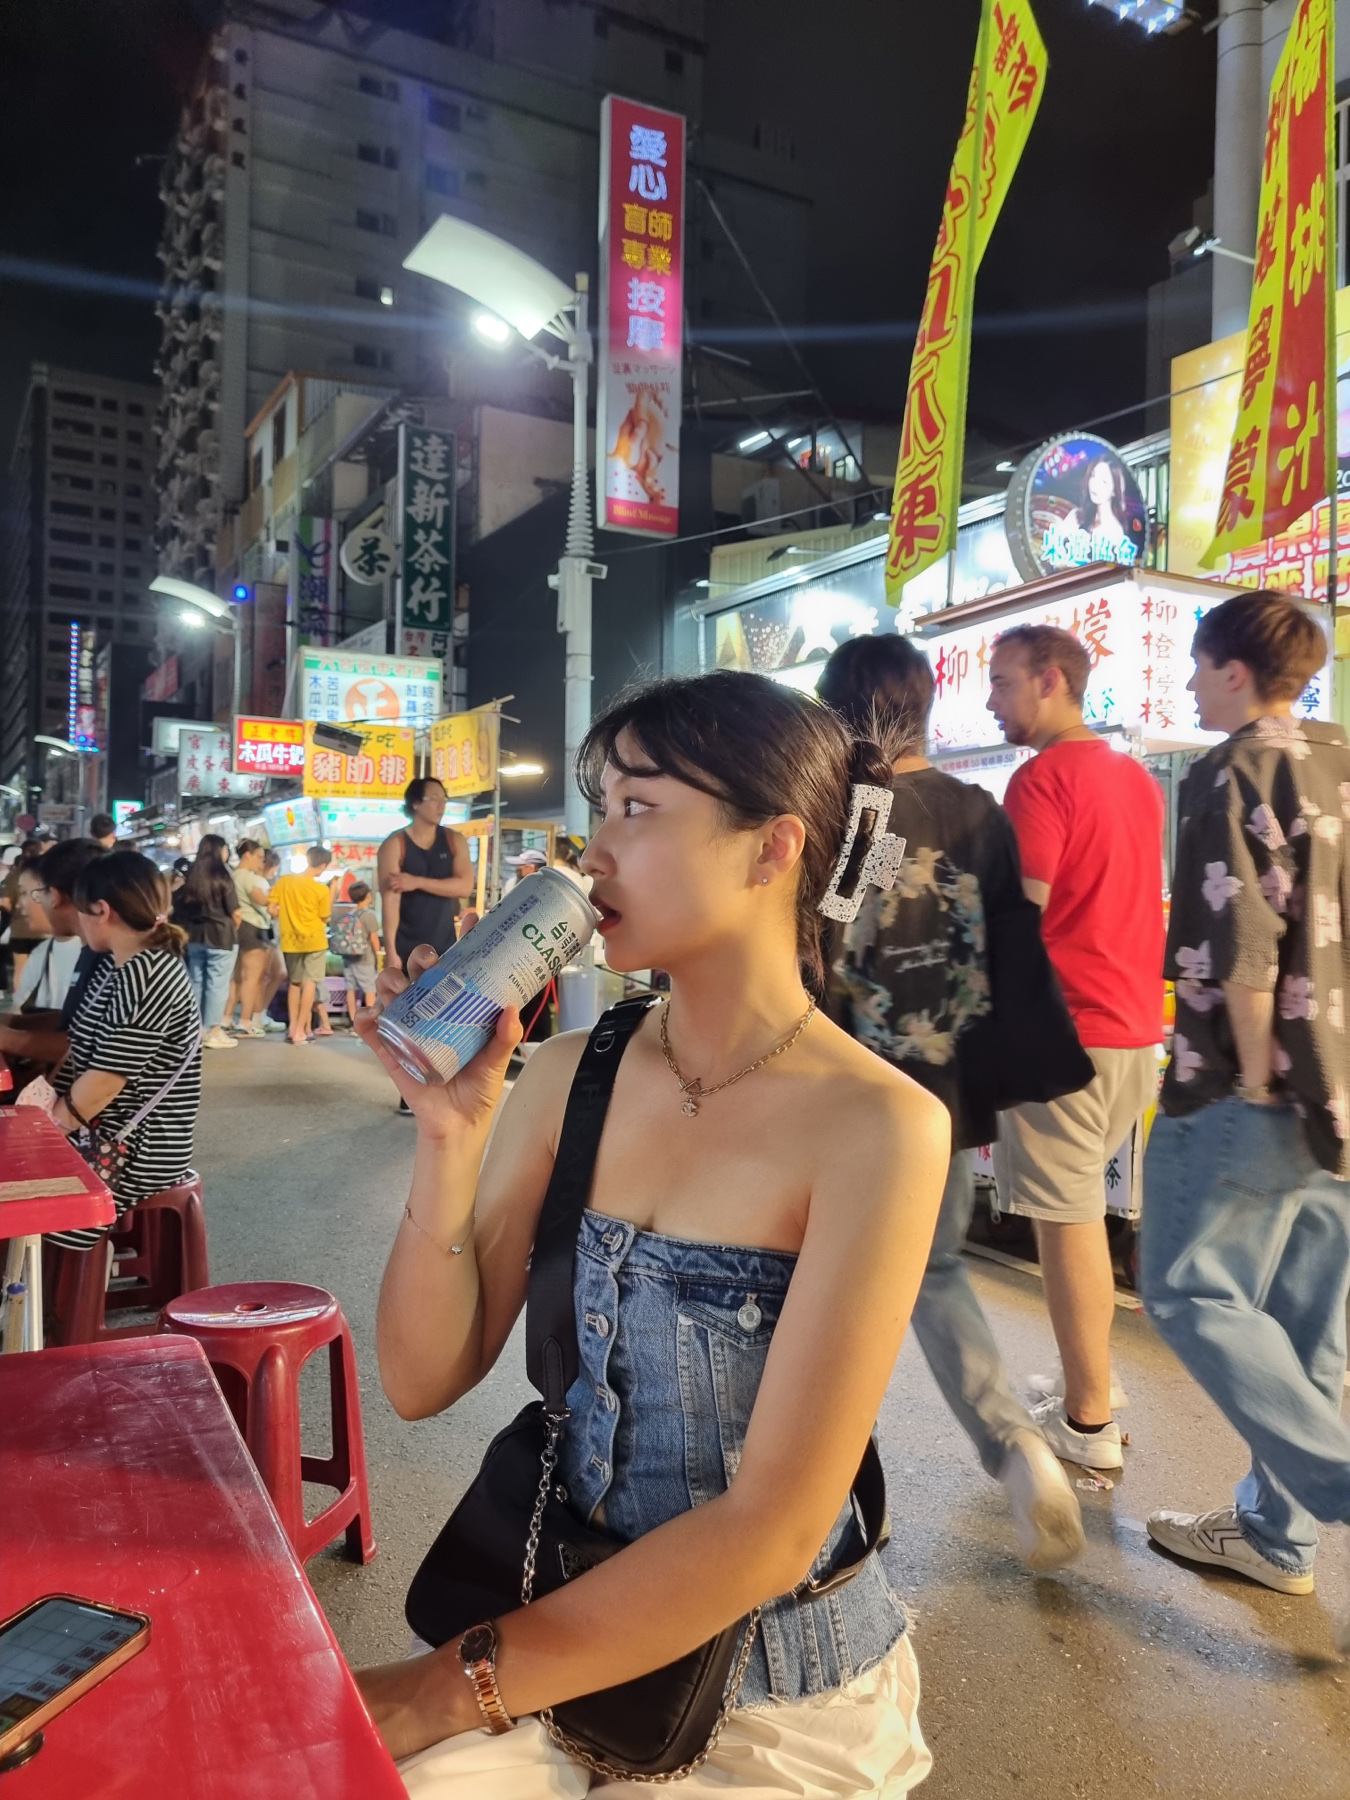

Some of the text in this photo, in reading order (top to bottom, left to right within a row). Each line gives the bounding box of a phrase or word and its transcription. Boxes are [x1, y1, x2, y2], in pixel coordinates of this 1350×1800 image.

[629, 124, 669, 201] 愛心
[622, 203, 673, 242] 盲師
[626, 276, 667, 352] 按摩
[351, 536, 392, 577] 茶
[936, 598, 1115, 700] 柳檬
[1139, 595, 1178, 729] 柳橙檸檬
